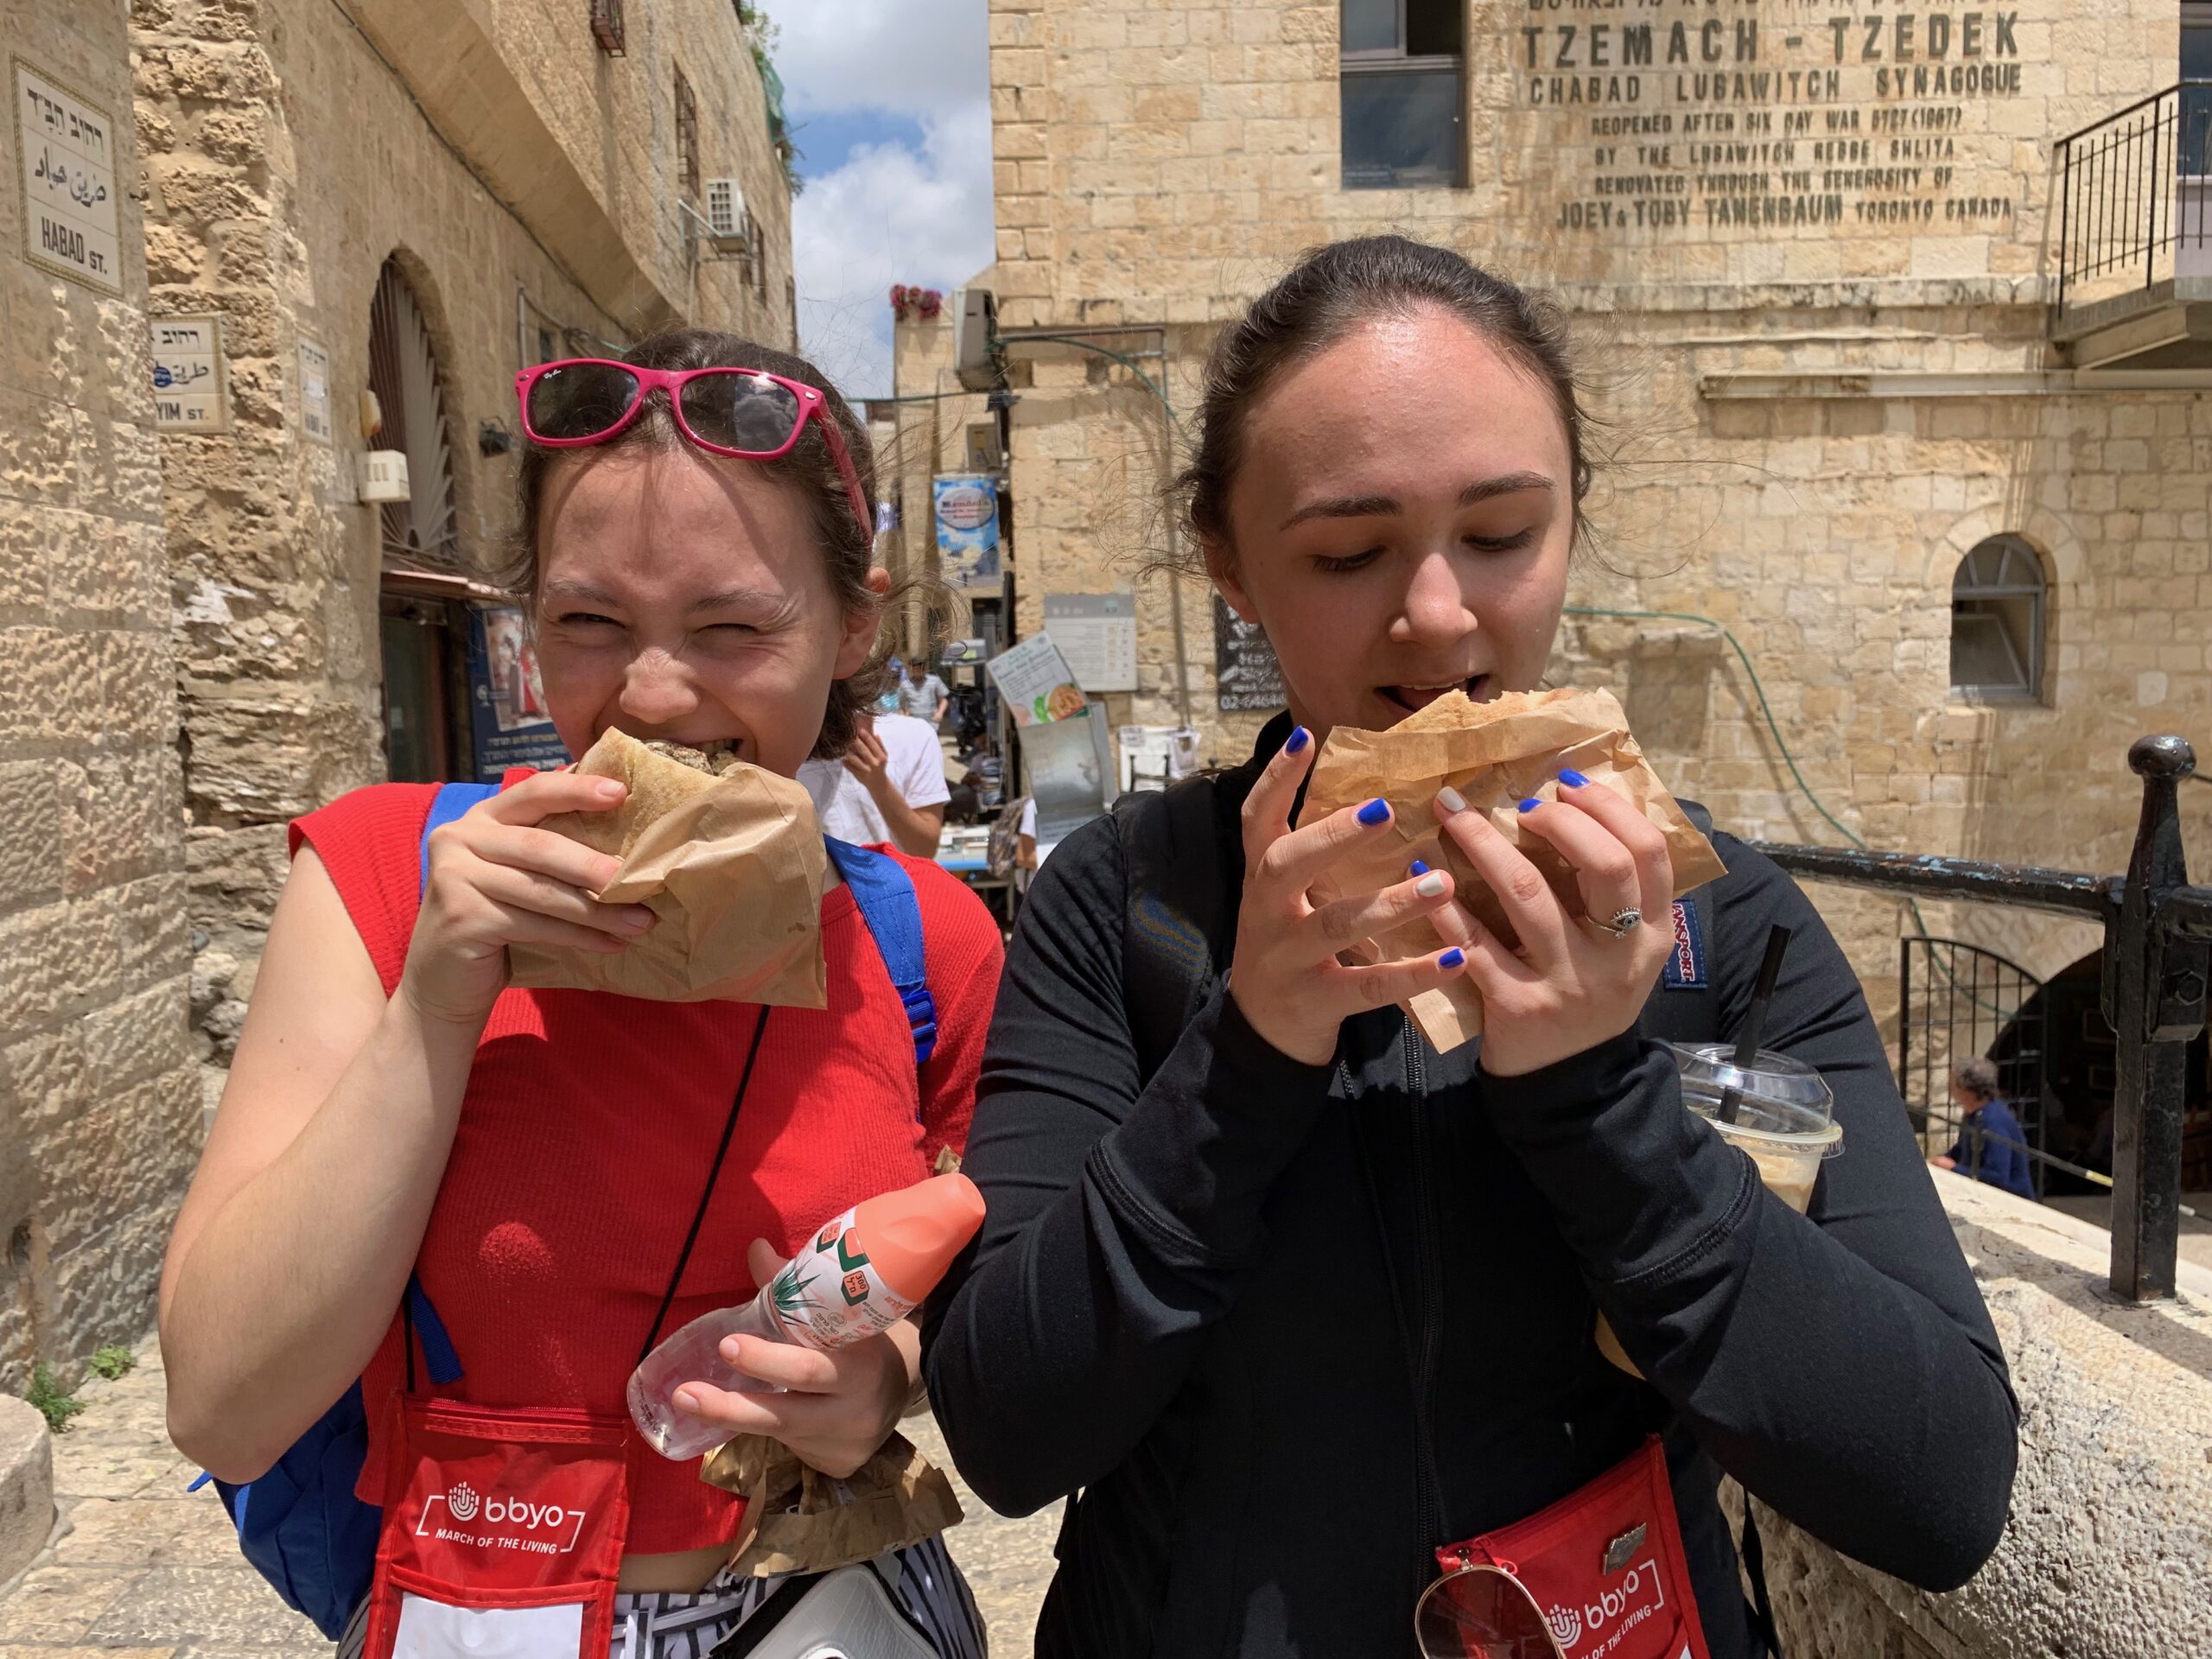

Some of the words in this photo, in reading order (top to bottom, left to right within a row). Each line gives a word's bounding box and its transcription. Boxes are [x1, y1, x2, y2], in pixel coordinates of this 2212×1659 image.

[1522, 19, 1758, 68] TZEMACH
[1829, 11, 2018, 60] TZEDEK
[1530, 76, 1640, 105] CHABAD
[1677, 71, 1840, 101] LUBAWITCH
[1877, 64, 2021, 97] SYNAGOGUE
[1592, 115, 1672, 135] REOPENED
[1685, 112, 1734, 132] AFTER
[1746, 111, 1771, 131] SIX
[1784, 111, 1812, 132] DAY
[1827, 110, 1859, 130] WAR
[1596, 148, 1616, 165] BY
[1638, 147, 1670, 165] THE
[1691, 143, 1795, 164] LUBAWITCH
[1815, 141, 1870, 162] REBBE
[1891, 138, 1954, 159] SHLITA
[1596, 175, 1685, 194] RENOVATED
[1697, 172, 1770, 192] THROUGH
[1781, 171, 1810, 190] THE
[1823, 168, 1921, 190] GENEROSITY
[1934, 166, 1953, 187] OF
[1557, 201, 1611, 229] JOEY
[1634, 198, 1691, 226] TOBY
[1705, 194, 1843, 228] TANENBAUM
[1857, 199, 1934, 223] TORONTO
[1947, 197, 2011, 221] CANADA
[41, 216, 85, 264] HABAD
[90, 250, 107, 275] ST.
[188, 408, 210, 420] ST.
[855, 1274, 867, 1290] 300
[485, 1496, 563, 1529] bbyo
[435, 1528, 474, 1545] MARCH
[477, 1537, 493, 1548] OF
[497, 1538, 519, 1549] THE
[521, 1539, 557, 1554] LIVING
[1585, 1570, 1639, 1630] bbyo
[1592, 1643, 1605, 1659] OF
[1607, 1629, 1621, 1651] THE
[1622, 1605, 1652, 1636] LIVING
